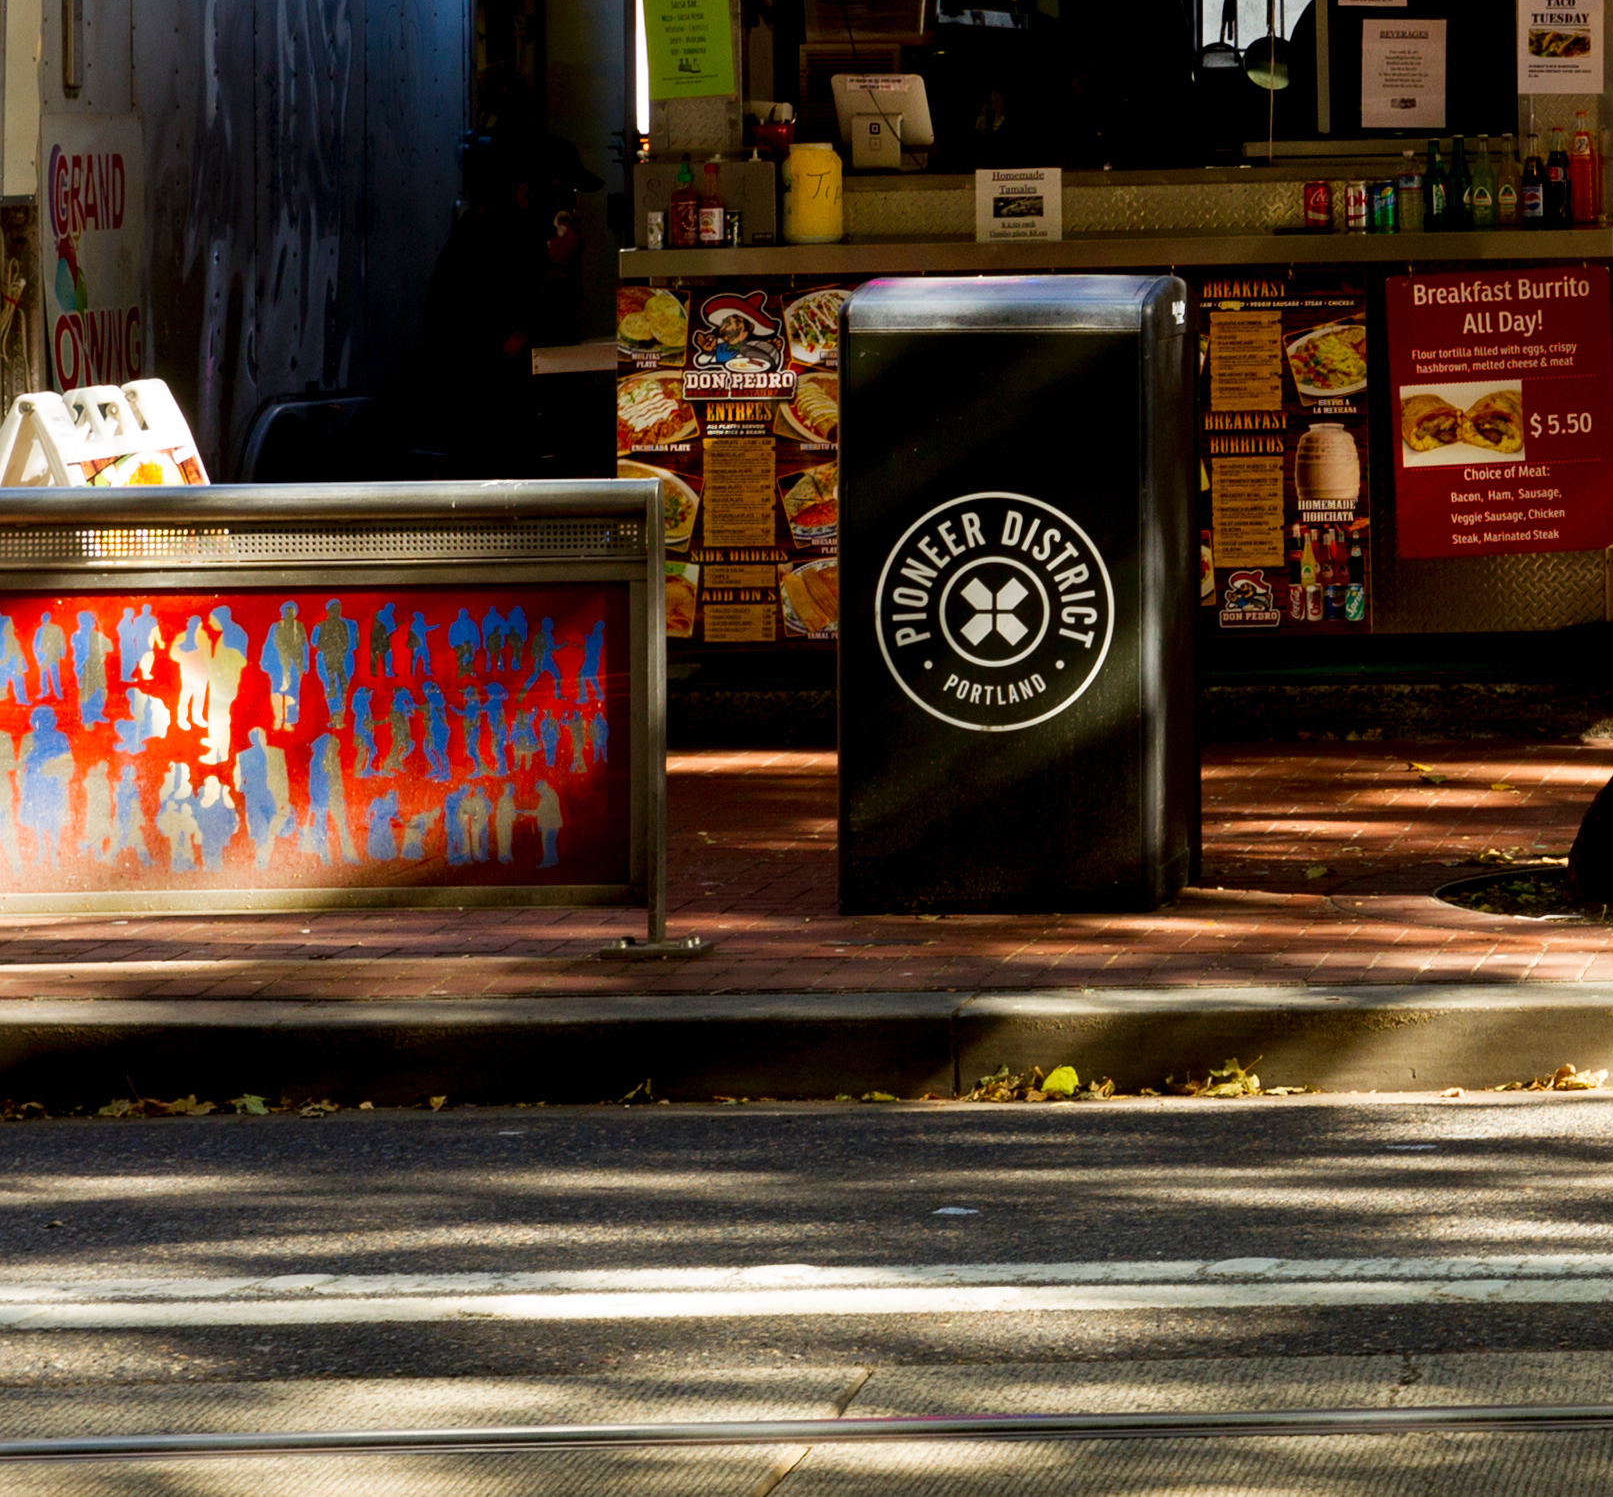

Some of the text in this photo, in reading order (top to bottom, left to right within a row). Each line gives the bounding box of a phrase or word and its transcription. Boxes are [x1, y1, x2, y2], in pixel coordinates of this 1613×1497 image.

[1531, 13, 1590, 23] TUESDAY
[1380, 30, 1429, 39] BEVERAGES
[992, 170, 1044, 181] Homemade
[55, 153, 125, 236] GRAND
[999, 184, 1036, 194] Tamales
[1203, 279, 1286, 298] BREAKFAST
[1413, 275, 1590, 306] Breakfast Burrito
[1463, 309, 1543, 337] All Day!
[1412, 342, 1577, 360] Flour tortilla filled with eggs, crispy
[1416, 356, 1573, 374] hashbrown, melted cheese & meat
[686, 373, 794, 389] DON PEDRO
[706, 402, 772, 422] ENTREES
[1204, 411, 1288, 430] BREAKFAST
[1530, 411, 1592, 438] $ 5.50
[1210, 434, 1285, 454] BURRITOS
[1463, 465, 1550, 481] Choice of Meat:
[1451, 487, 1562, 503] Bacon, Ham, Sausage,
[1298, 499, 1356, 511] HOMEMADE
[1302, 511, 1354, 522] HORCHATA
[1451, 507, 1565, 526] Veggie Sausage, Chicken
[1452, 528, 1560, 545] Steak, Marinated Steak
[690, 550, 788, 562] SIDE ORDERS
[892, 510, 1098, 649] PIONEER DISTRICT
[702, 589, 734, 602] ADD
[1222, 611, 1277, 621] DON PEDRO
[943, 673, 1047, 706] PORTLAND
